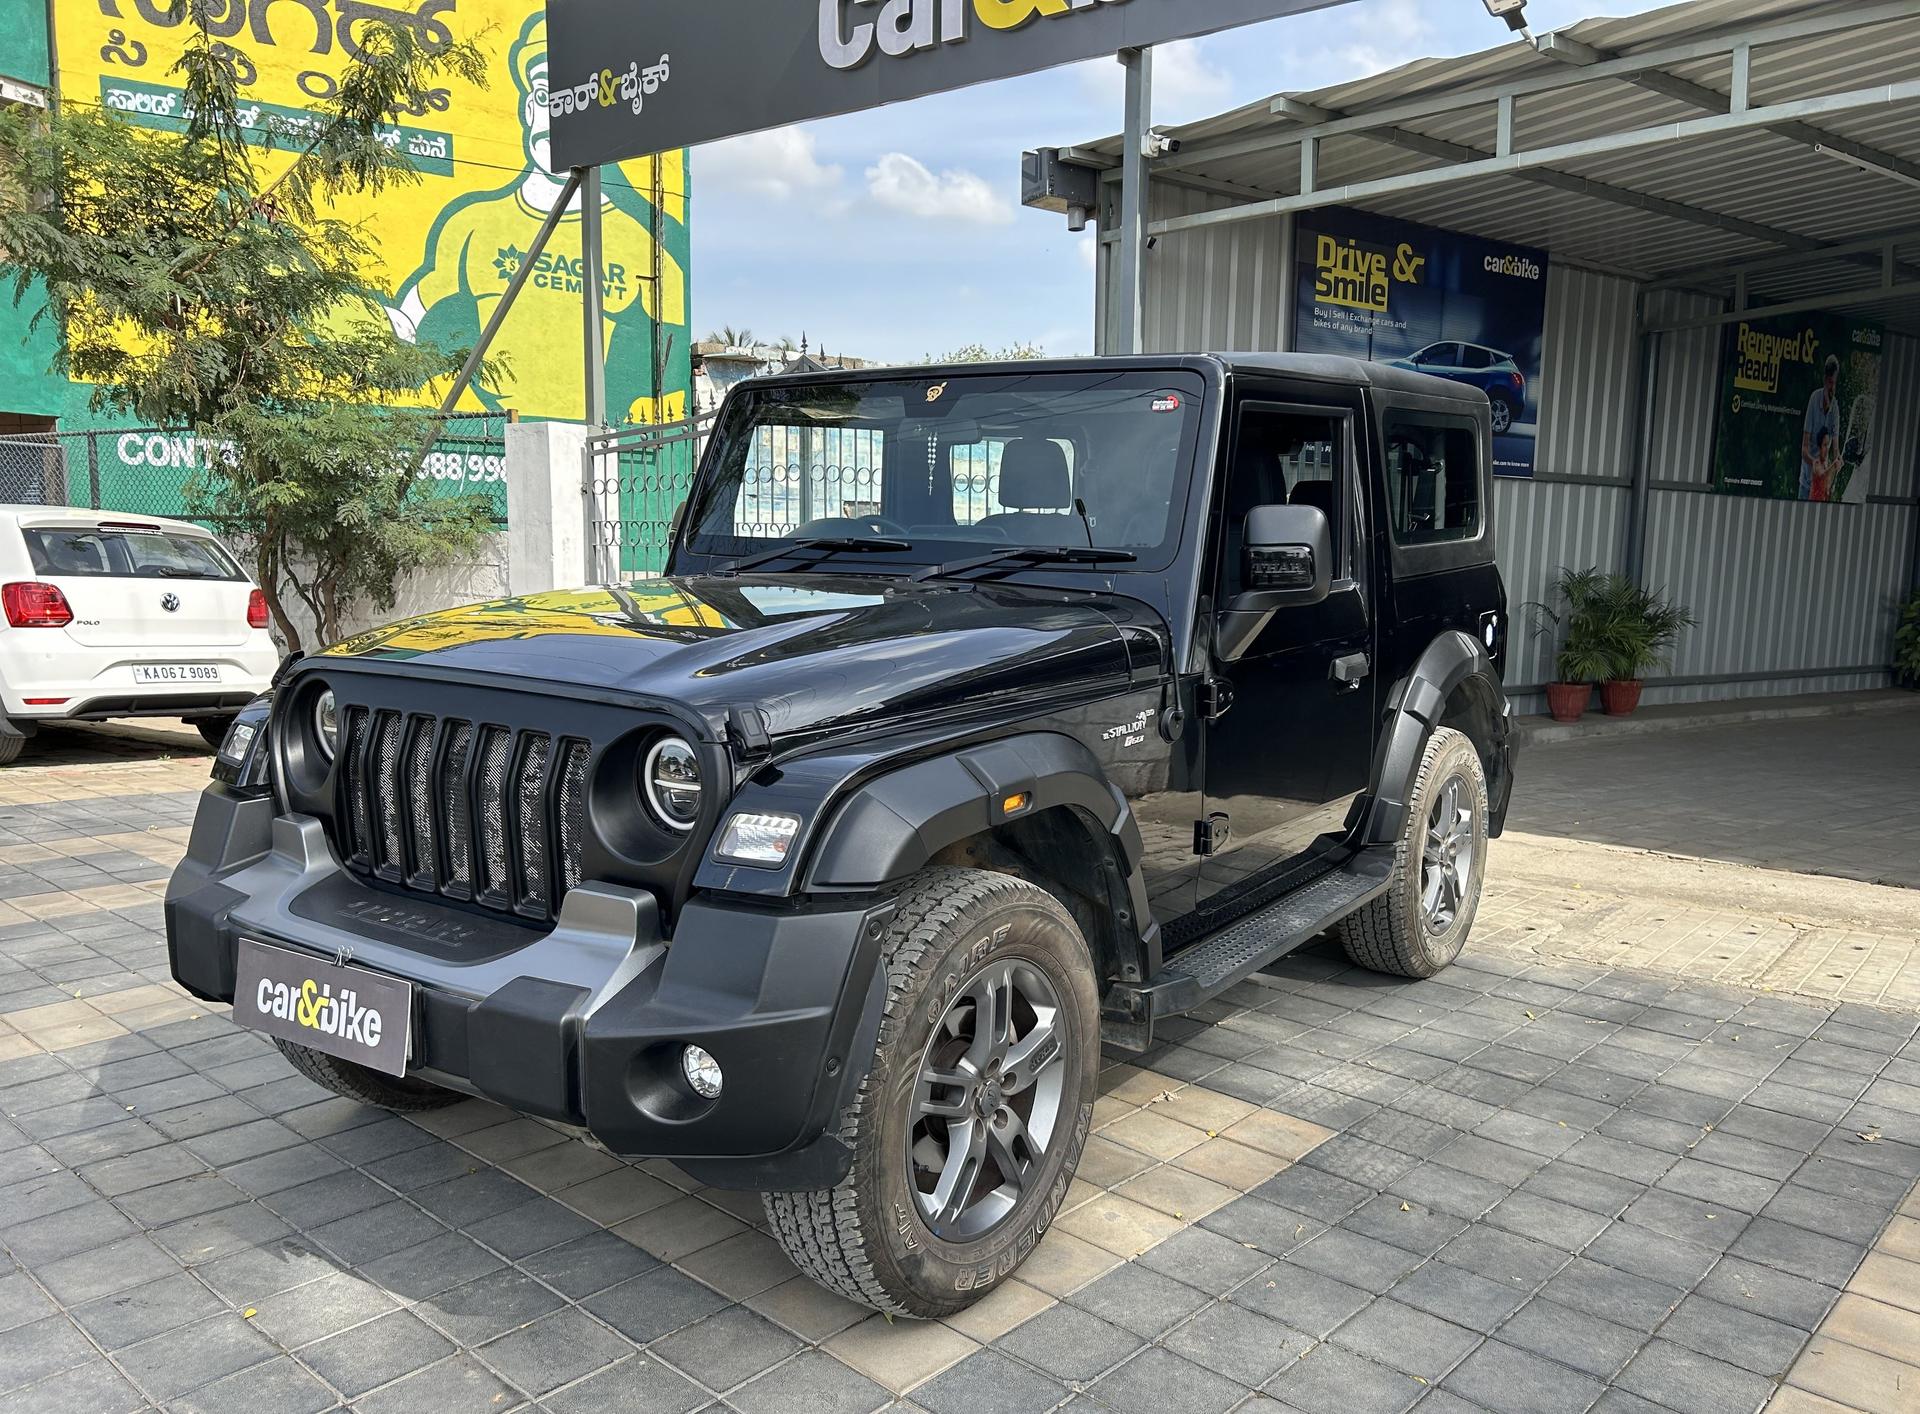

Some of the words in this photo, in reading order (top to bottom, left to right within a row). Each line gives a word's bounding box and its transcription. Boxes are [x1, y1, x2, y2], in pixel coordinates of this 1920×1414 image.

[1316, 234, 1387, 276] Drive
[1392, 243, 1425, 284] &
[1483, 255, 1540, 280] car&bike
[1315, 266, 1386, 307] Smile
[1313, 319, 1331, 329] bikes
[1332, 320, 1339, 330] of
[1340, 323, 1353, 333] any
[1314, 307, 1328, 319] Buy
[1333, 310, 1345, 320] Sell
[1394, 321, 1407, 329] and
[1737, 321, 1801, 362] Renewed
[256, 977, 383, 1048] car&bike
